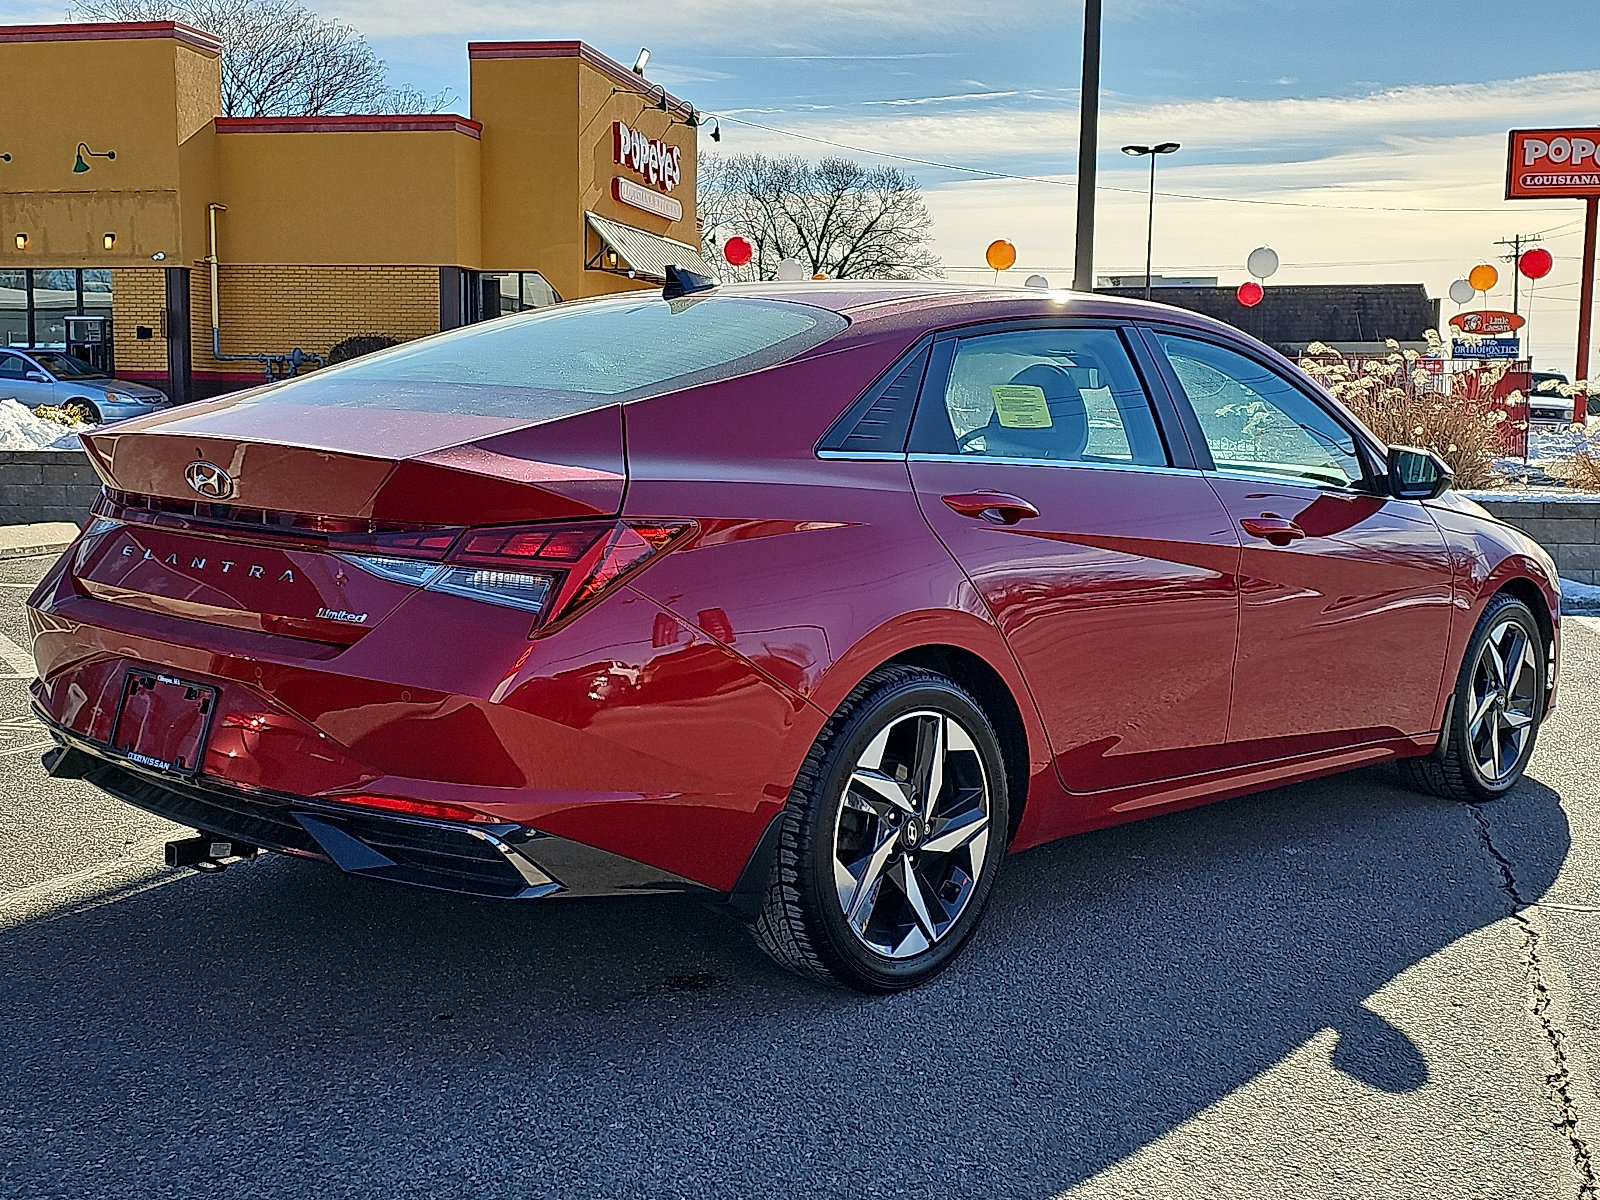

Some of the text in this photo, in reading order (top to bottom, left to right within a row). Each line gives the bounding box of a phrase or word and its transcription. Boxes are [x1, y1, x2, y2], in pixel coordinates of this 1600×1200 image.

[1523, 136, 1600, 168] POP
[1525, 175, 1600, 186] LOUISIANA
[1482, 323, 1511, 331] Caesars
[1489, 316, 1509, 325] Little
[121, 545, 296, 583] ELANTRA
[315, 607, 368, 623] Limited
[141, 755, 170, 770] NISSAN
